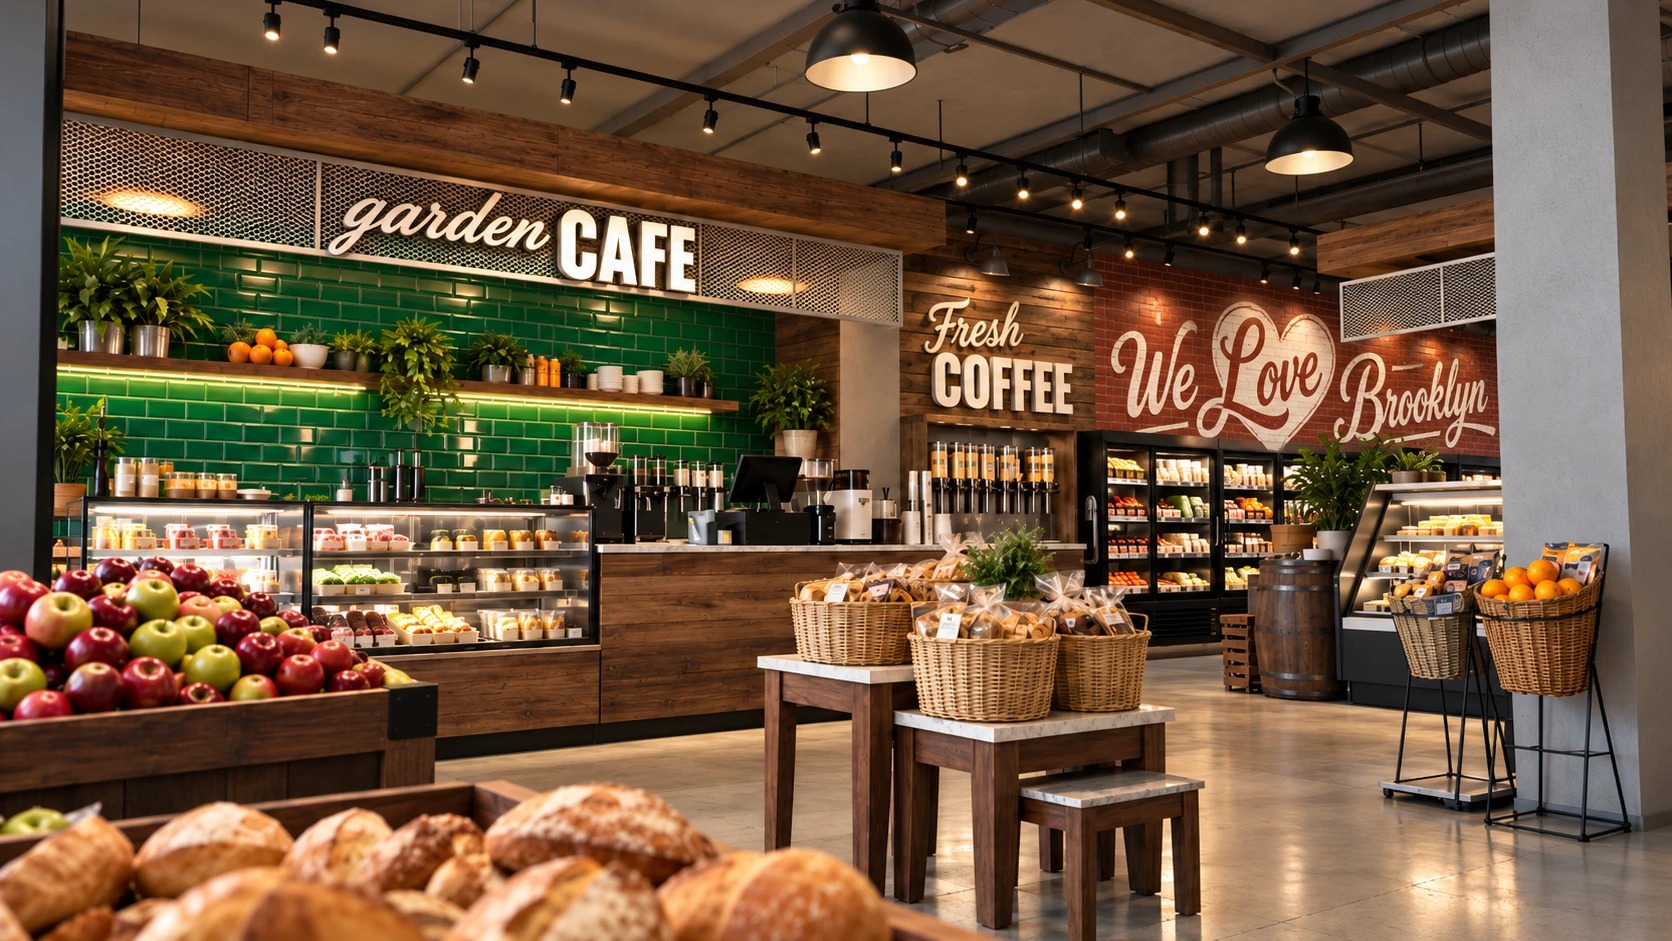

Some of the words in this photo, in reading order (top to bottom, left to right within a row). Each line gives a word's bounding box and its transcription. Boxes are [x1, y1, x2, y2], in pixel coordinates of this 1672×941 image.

[328, 192, 551, 256] garden
[557, 208, 696, 292] CAFE
[924, 297, 1024, 353] Fresh
[931, 352, 1074, 414] COFFEE
[1110, 320, 1198, 418] We
[1197, 317, 1322, 438] Love
[1333, 352, 1496, 448] Brooklyn
